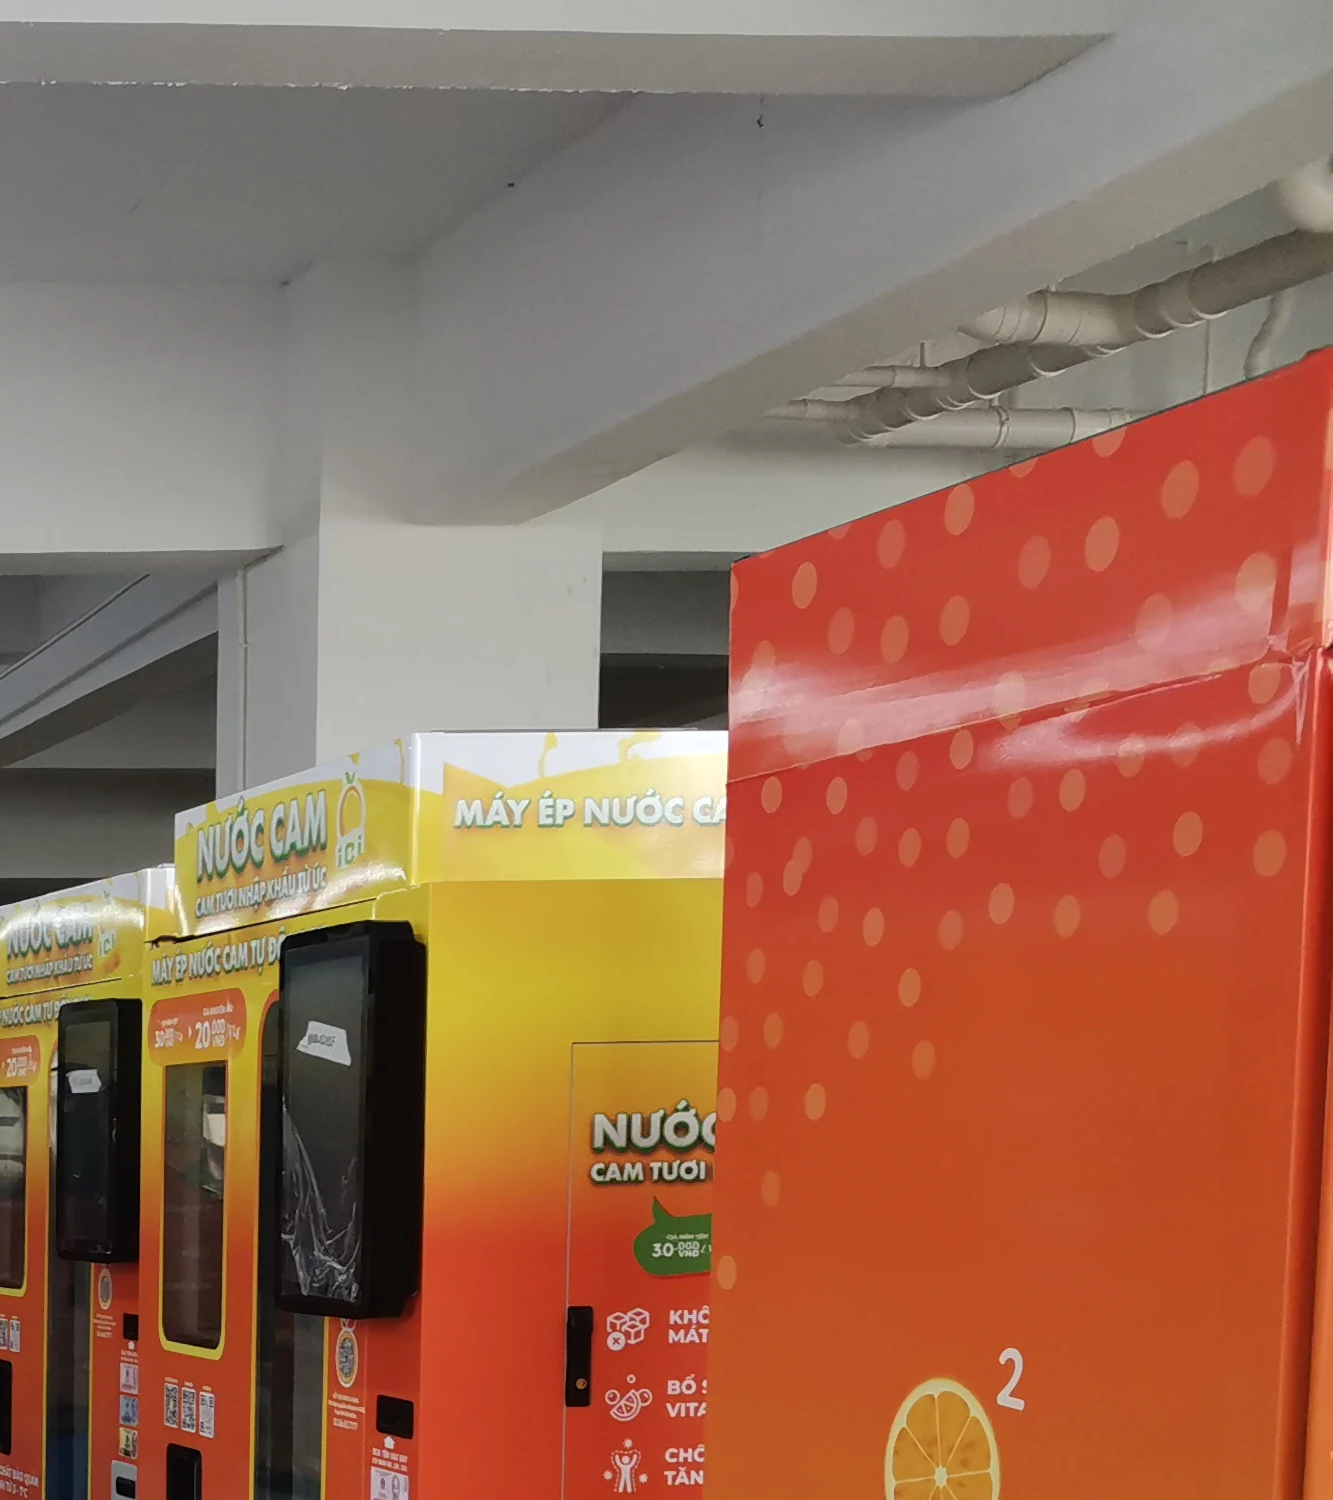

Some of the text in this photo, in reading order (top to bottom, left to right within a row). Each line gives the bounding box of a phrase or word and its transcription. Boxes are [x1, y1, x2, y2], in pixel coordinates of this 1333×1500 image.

[453, 787, 685, 829] MÁY ÉP NƯỚC
[196, 789, 327, 884] NƯỚC CAM
[195, 876, 266, 919] CAM NHẬP
[151, 937, 267, 986] MÁY ÉP NƯỚC CAM TỰ
[590, 1159, 707, 1184] CAM TƯƠI
[669, 1324, 709, 1344] MÁT
[667, 1374, 697, 1395] BỔ
[994, 1347, 1027, 1412] 2
